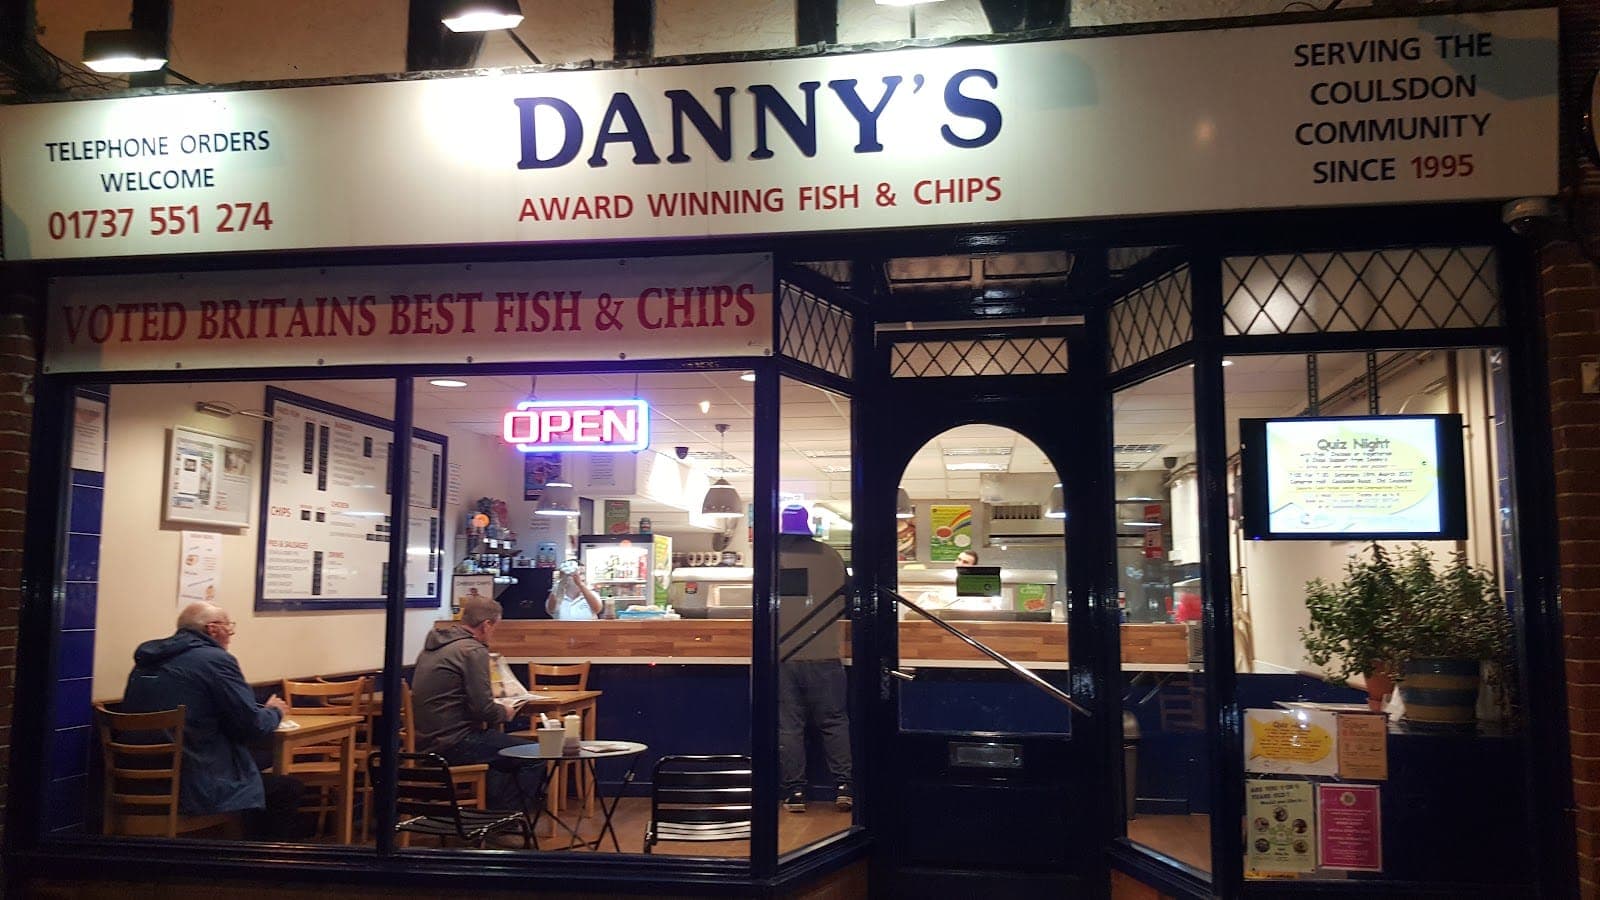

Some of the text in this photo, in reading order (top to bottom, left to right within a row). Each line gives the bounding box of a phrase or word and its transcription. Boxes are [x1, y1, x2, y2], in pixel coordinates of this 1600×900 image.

[1294, 33, 1493, 67] SERVING THE
[1310, 75, 1477, 105] COULSDON
[514, 68, 1003, 170] DANNY'S
[1295, 113, 1492, 145] COMMUNITY
[45, 130, 270, 162] TELEPHONE ORDERS
[101, 168, 215, 193] WELCOME
[1313, 154, 1474, 184] SINCE 1995
[519, 176, 1001, 221] AWARD WINNING FISH & CHIPS
[48, 201, 273, 240] 01737 551 274
[63, 284, 755, 345] VOTED BRITAINS BEST FISH & CHIPS
[503, 409, 636, 443] OPEN
[1317, 438, 1390, 452] Quiz Night
[271, 506, 292, 518] CHIPS
